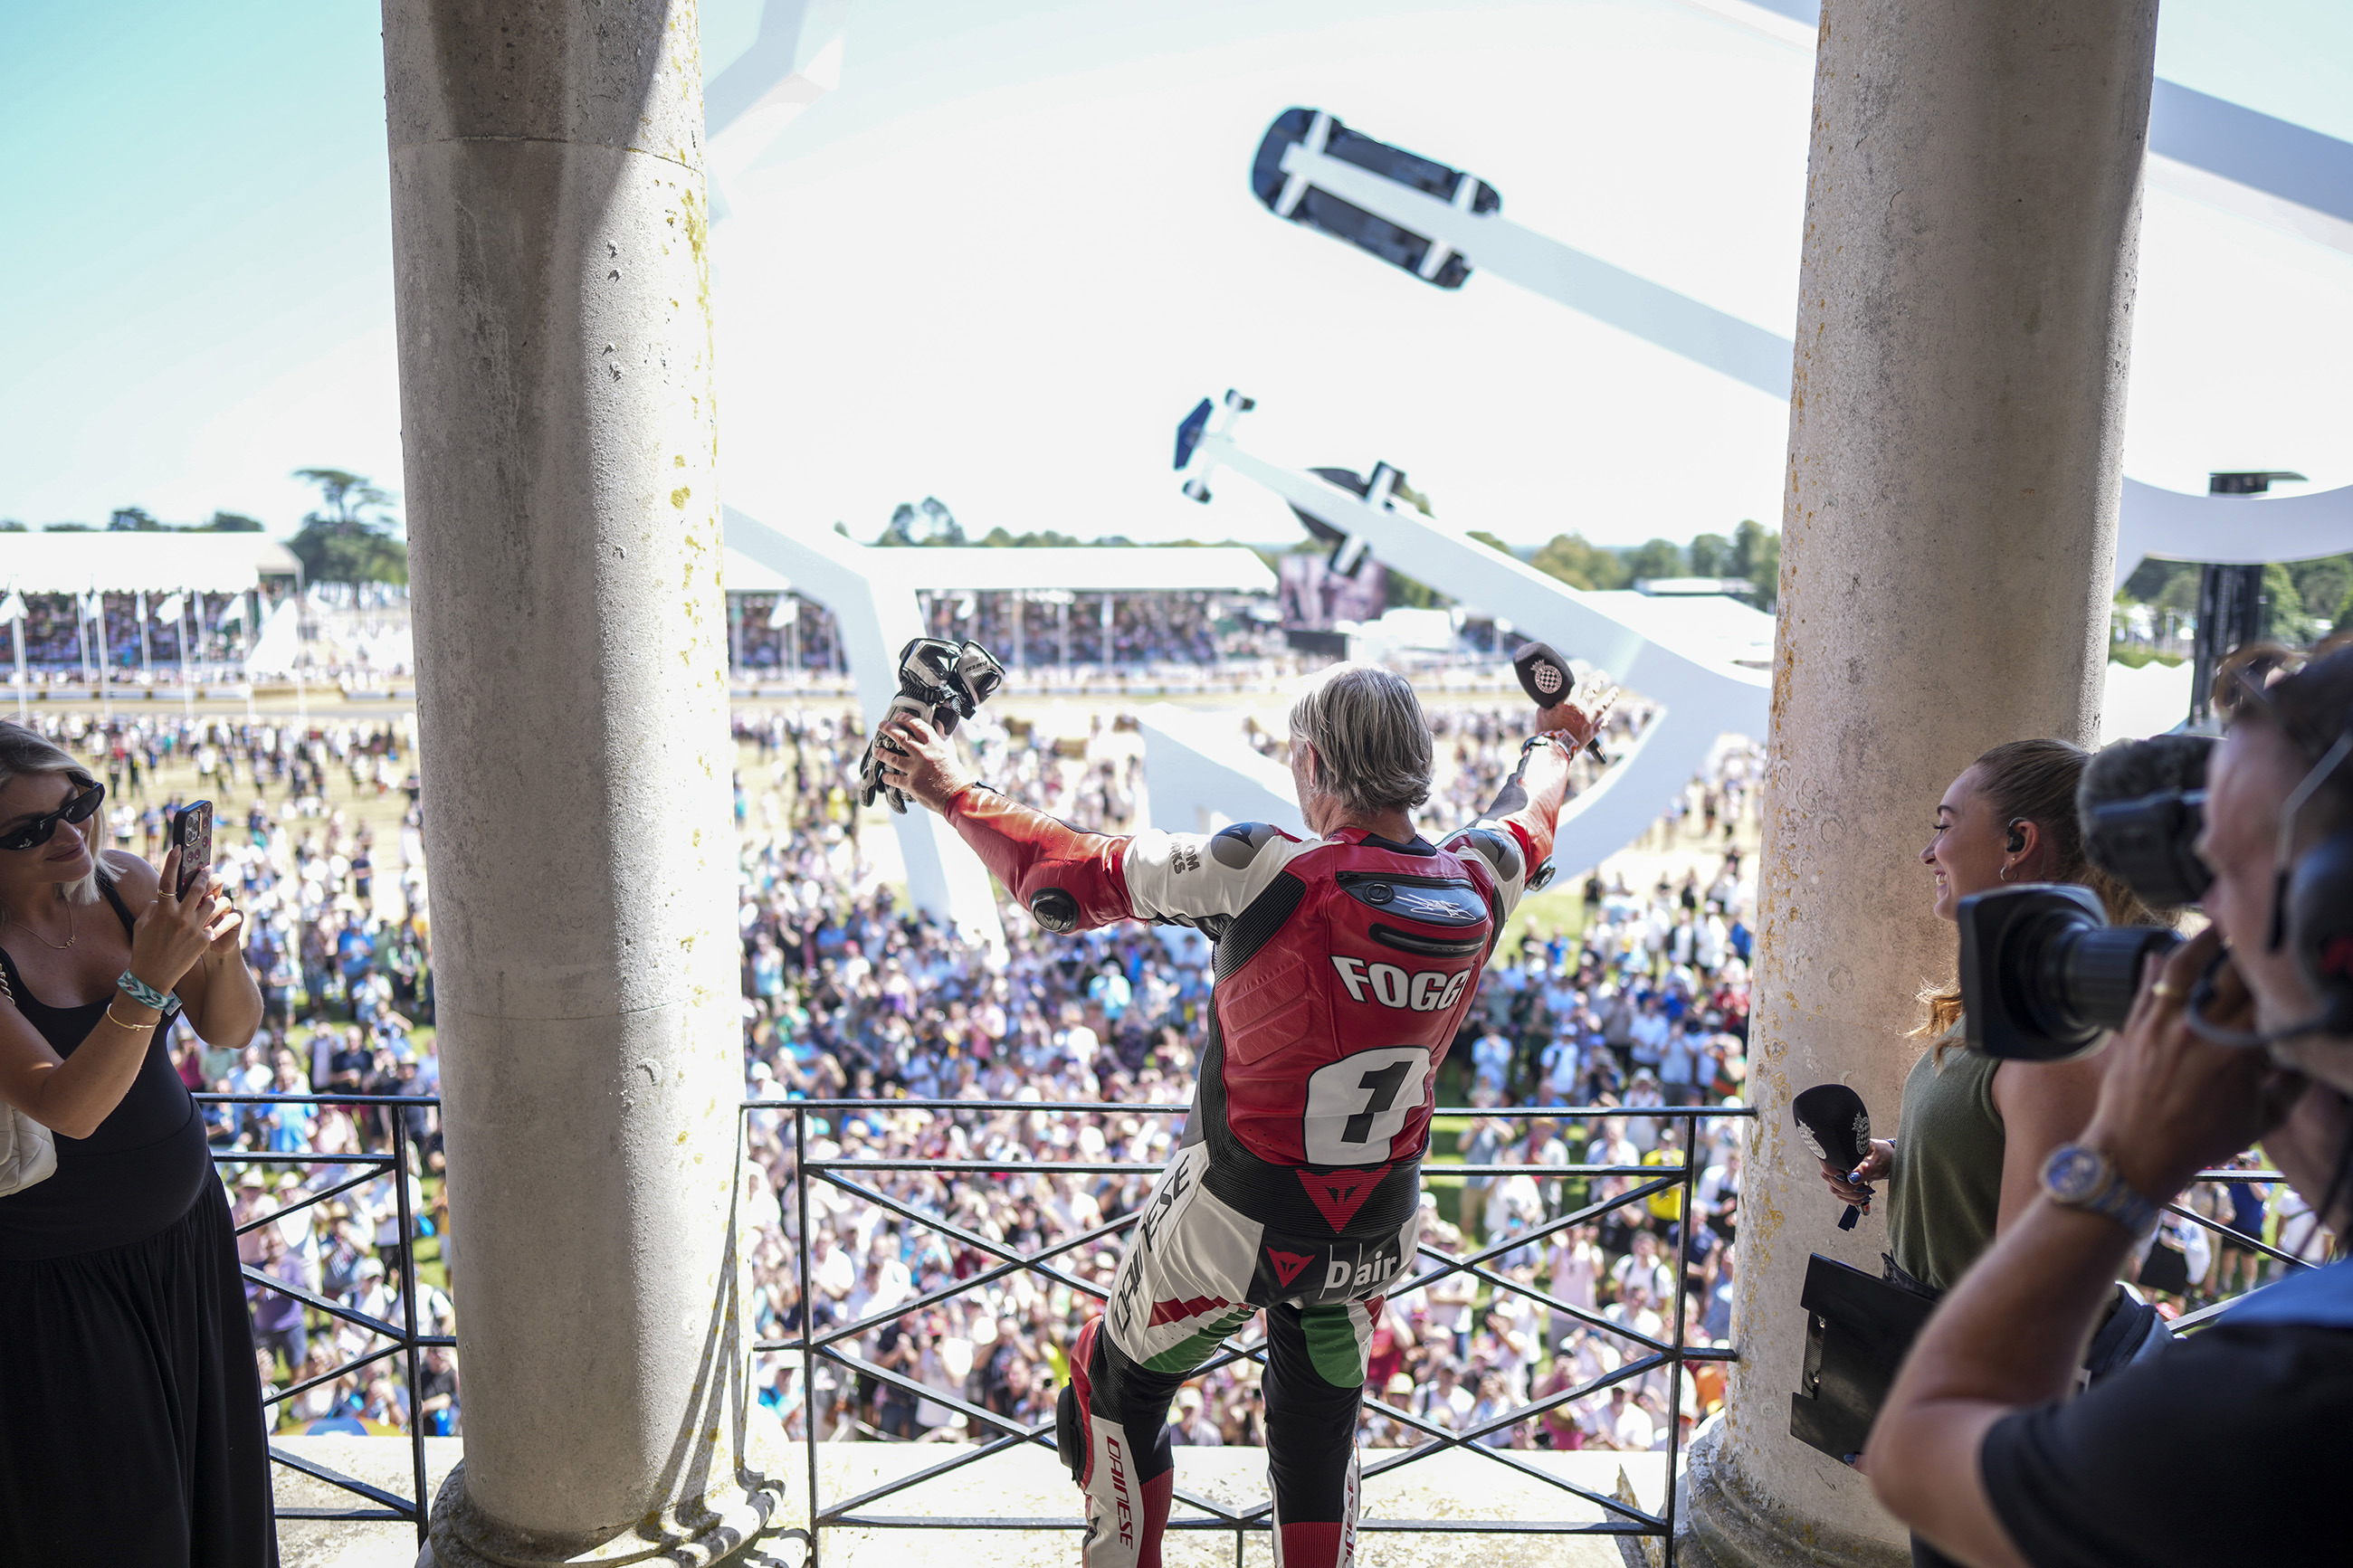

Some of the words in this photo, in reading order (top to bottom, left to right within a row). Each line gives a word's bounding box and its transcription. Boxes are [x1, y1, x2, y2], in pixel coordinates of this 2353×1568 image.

[1329, 955, 1476, 1012] FOGG
[1341, 1060, 1414, 1144] 1
[1106, 1435, 1134, 1550] DAINESE
